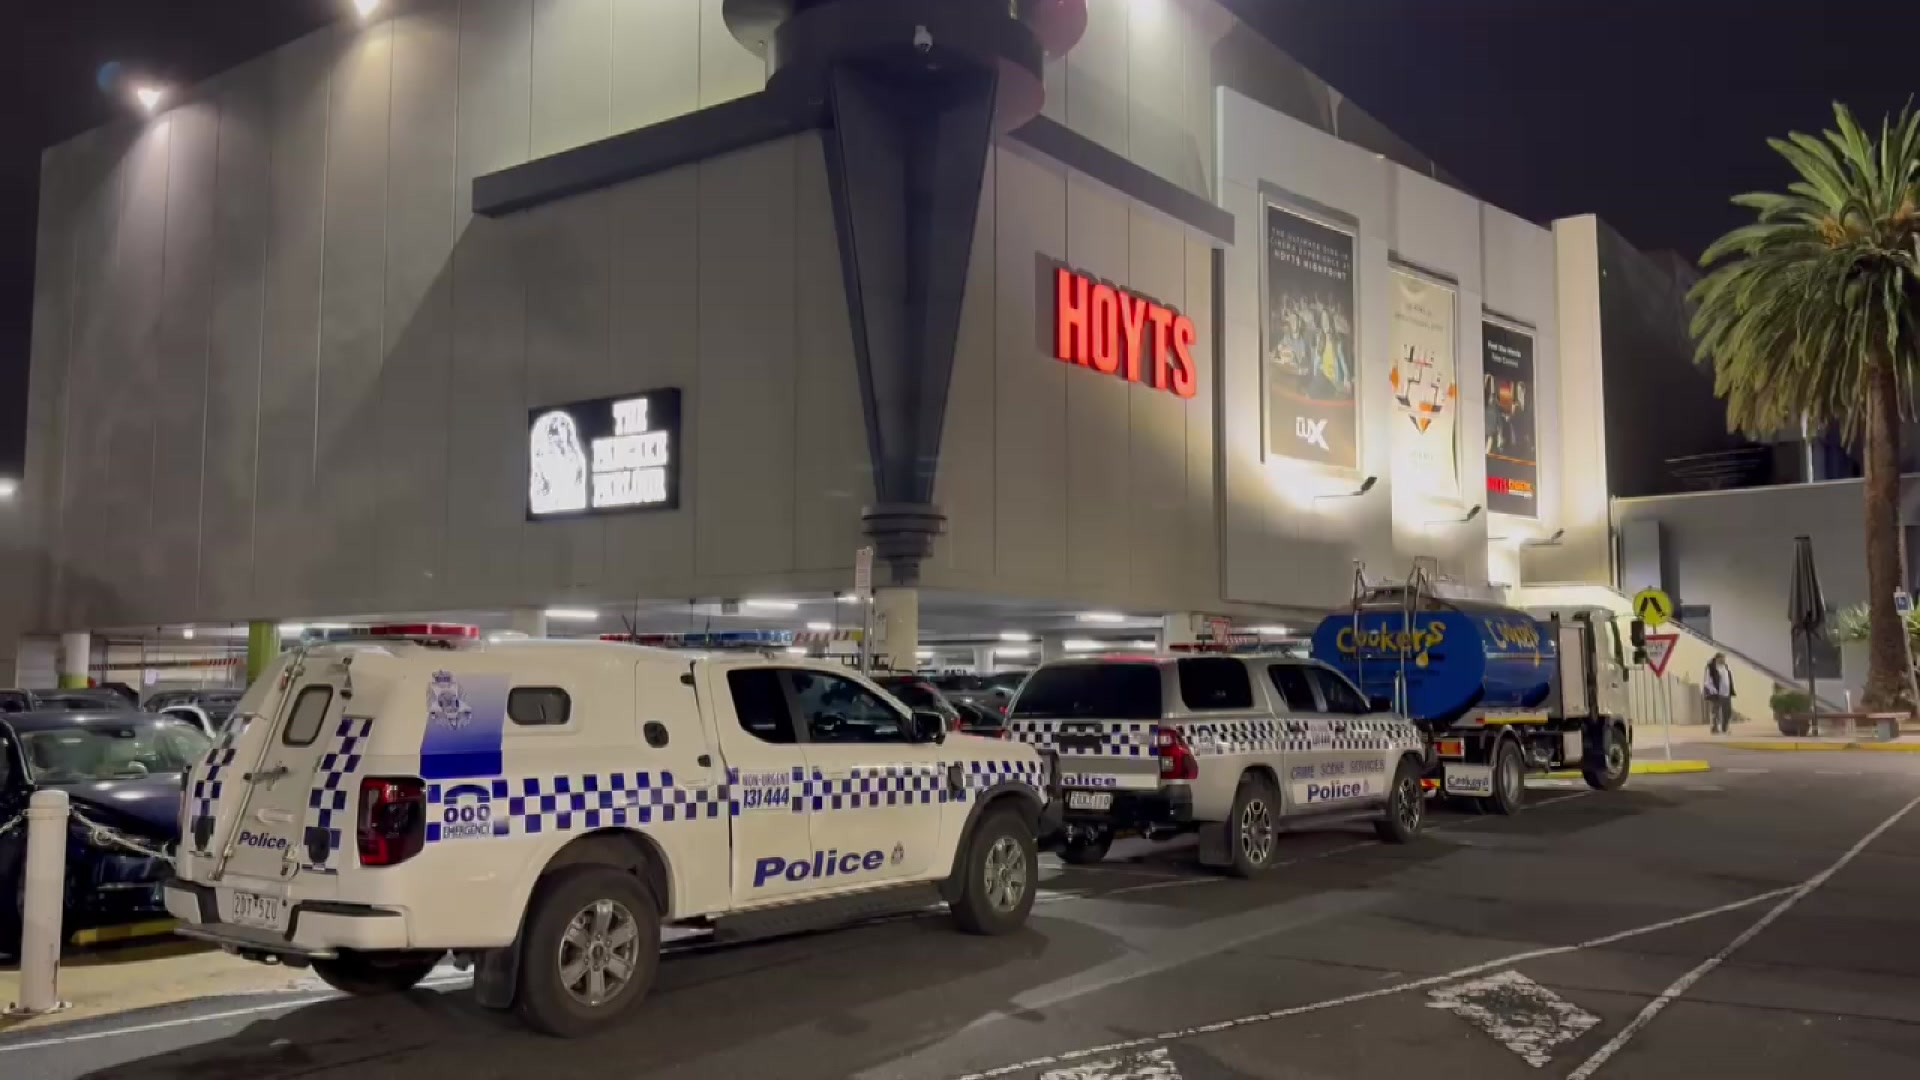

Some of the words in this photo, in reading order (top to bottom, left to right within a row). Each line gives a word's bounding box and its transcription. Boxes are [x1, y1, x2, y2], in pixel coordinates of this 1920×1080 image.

[1056, 267, 1197, 399] HOYTS
[1350, 759, 1385, 774] SERVICES
[1307, 780, 1361, 802] Police
[444, 805, 491, 823] 000
[238, 831, 287, 849] Police
[443, 823, 490, 839] EMERGENCY
[753, 848, 885, 888] Police
